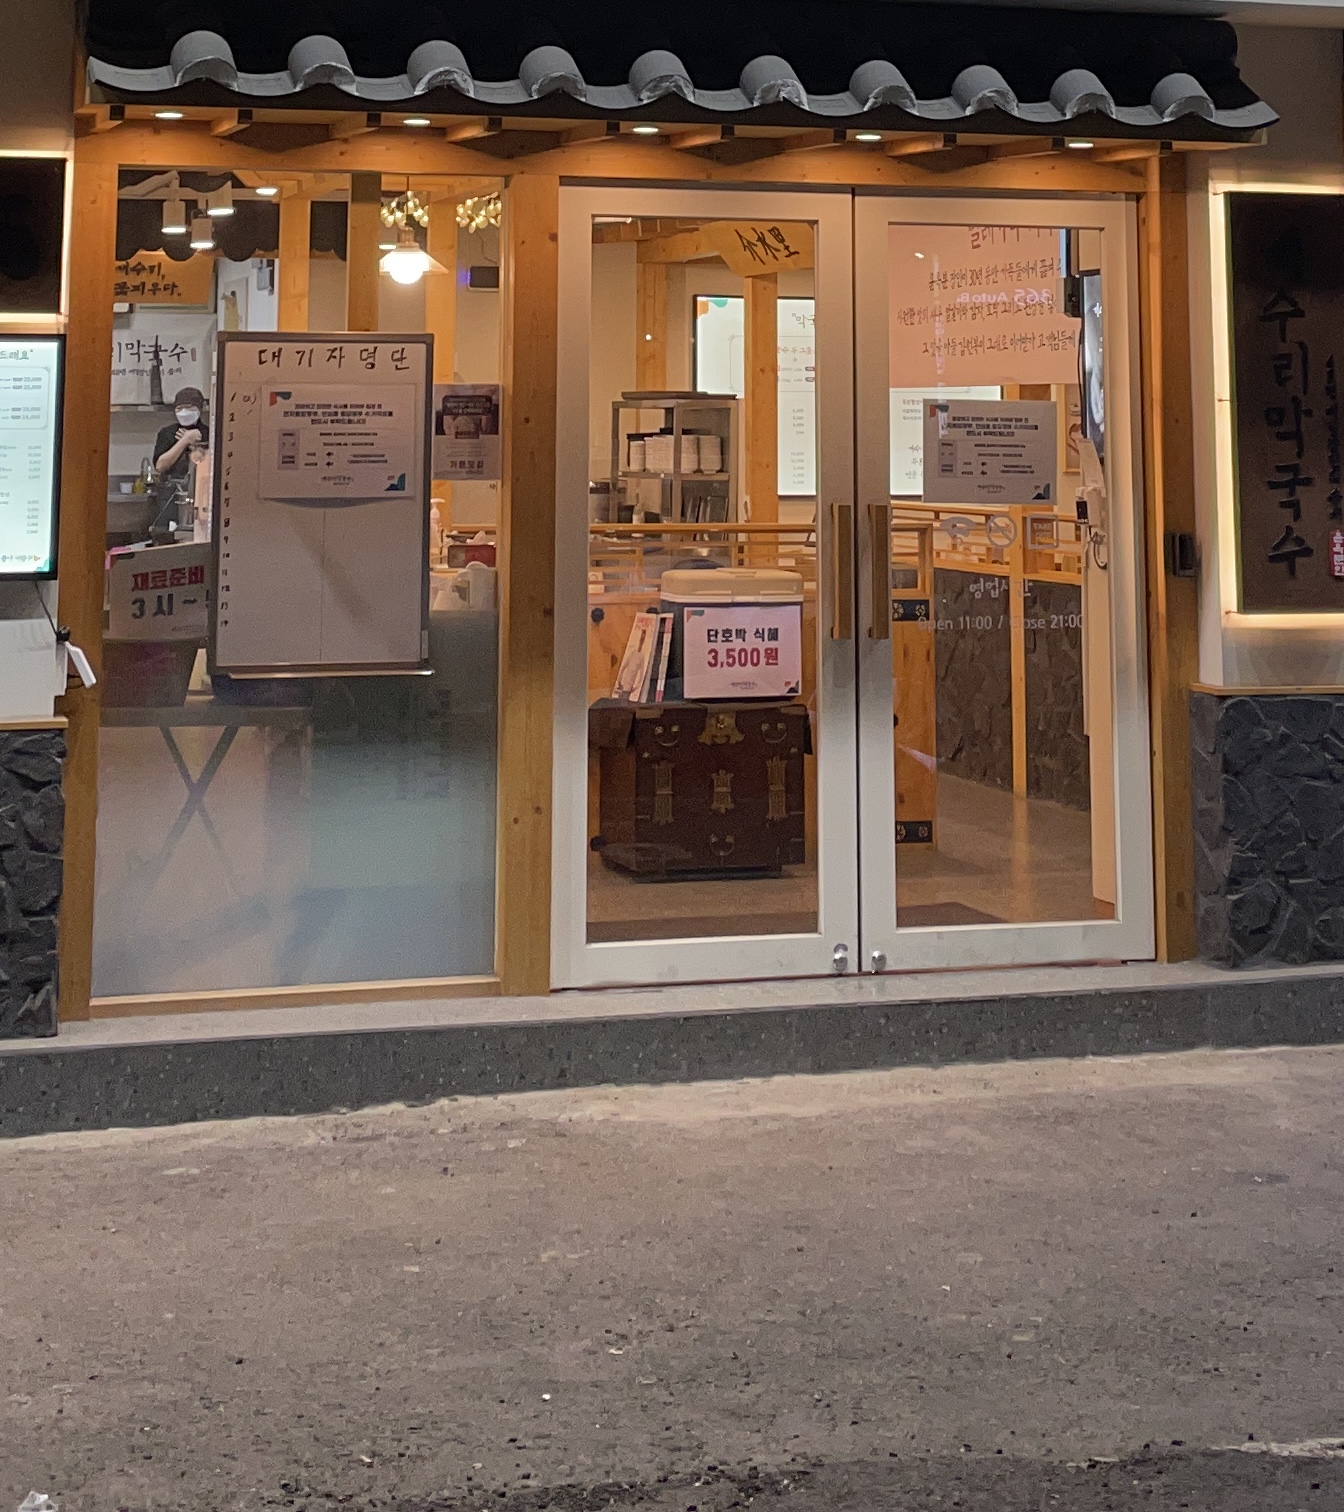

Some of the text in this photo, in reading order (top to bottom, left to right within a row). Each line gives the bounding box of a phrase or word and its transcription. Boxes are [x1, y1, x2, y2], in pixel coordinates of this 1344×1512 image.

[131, 564, 205, 592] 재료준비
[959, 615, 993, 631] 11:00
[706, 627, 747, 644] 단호박
[706, 646, 780, 669] 3,500원
